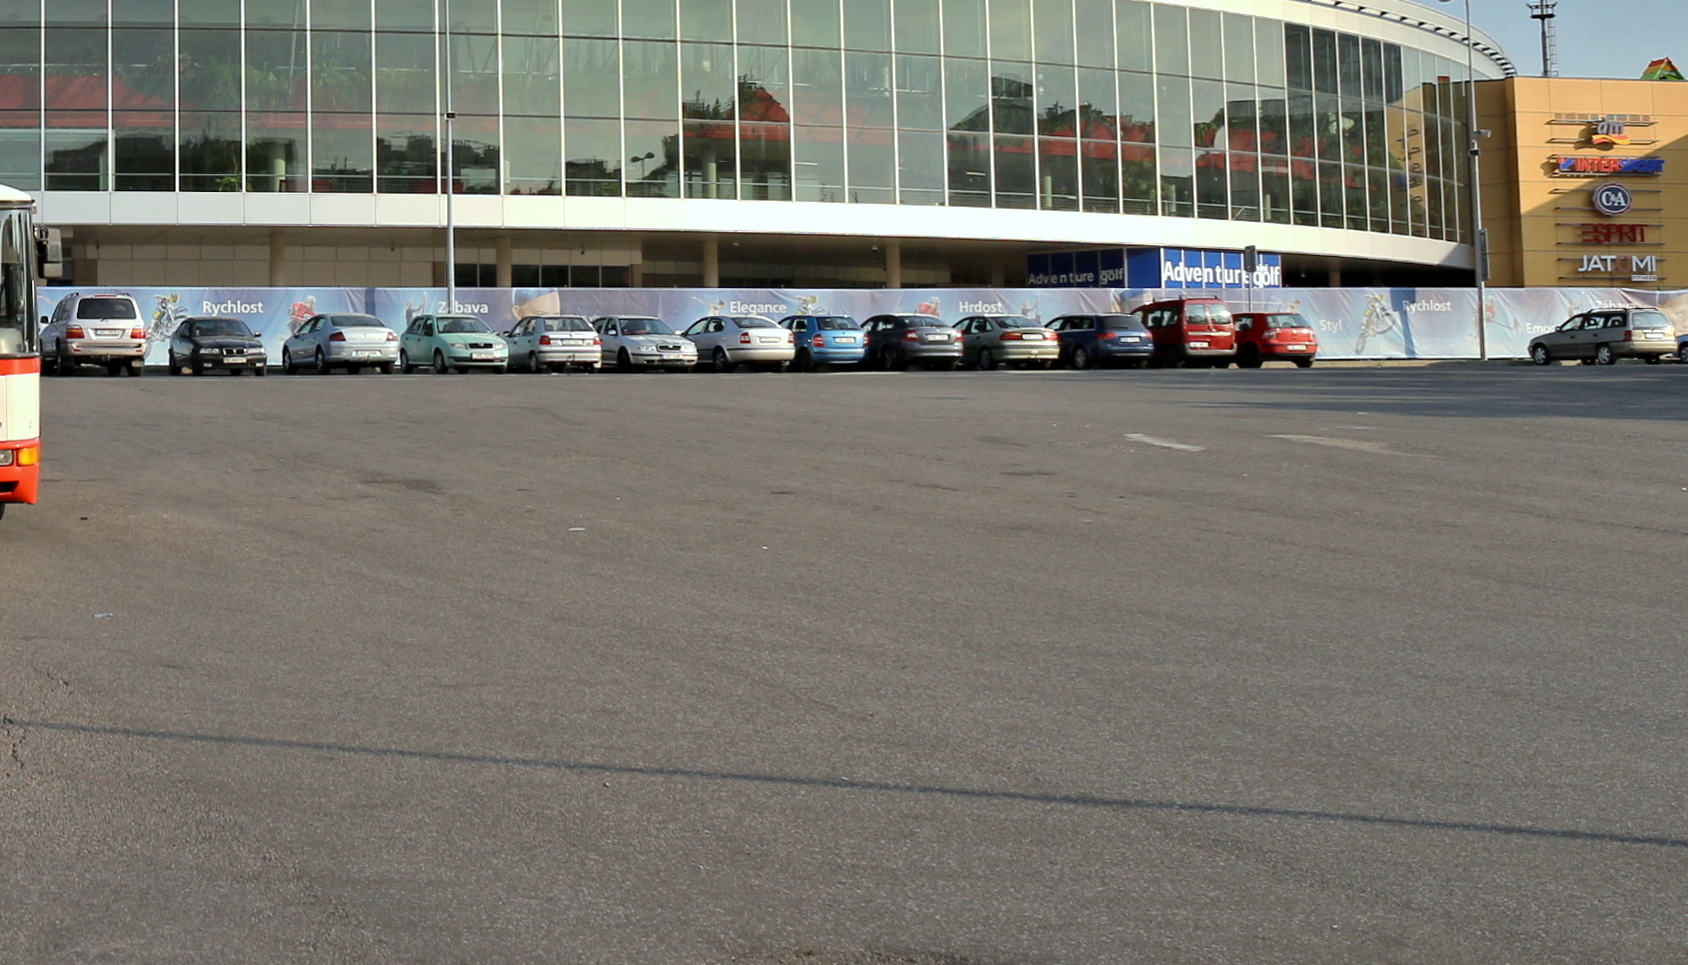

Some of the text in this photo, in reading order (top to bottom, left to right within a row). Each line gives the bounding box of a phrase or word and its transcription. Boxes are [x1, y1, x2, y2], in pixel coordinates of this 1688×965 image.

[1597, 116, 1624, 135] dm
[1601, 191, 1626, 206] C&A
[1581, 223, 1649, 243] ESPRIT
[1578, 255, 1656, 272] JATOMI
[1028, 268, 1125, 285] Adventure golf
[1253, 266, 1281, 288] golf
[202, 300, 264, 317] Rychlost
[438, 301, 489, 314] Zbava
[729, 301, 787, 316] Elegance
[959, 301, 1003, 313] Hrdost
[1402, 299, 1452, 314] Rychlost
[1320, 319, 1342, 334] Styl
